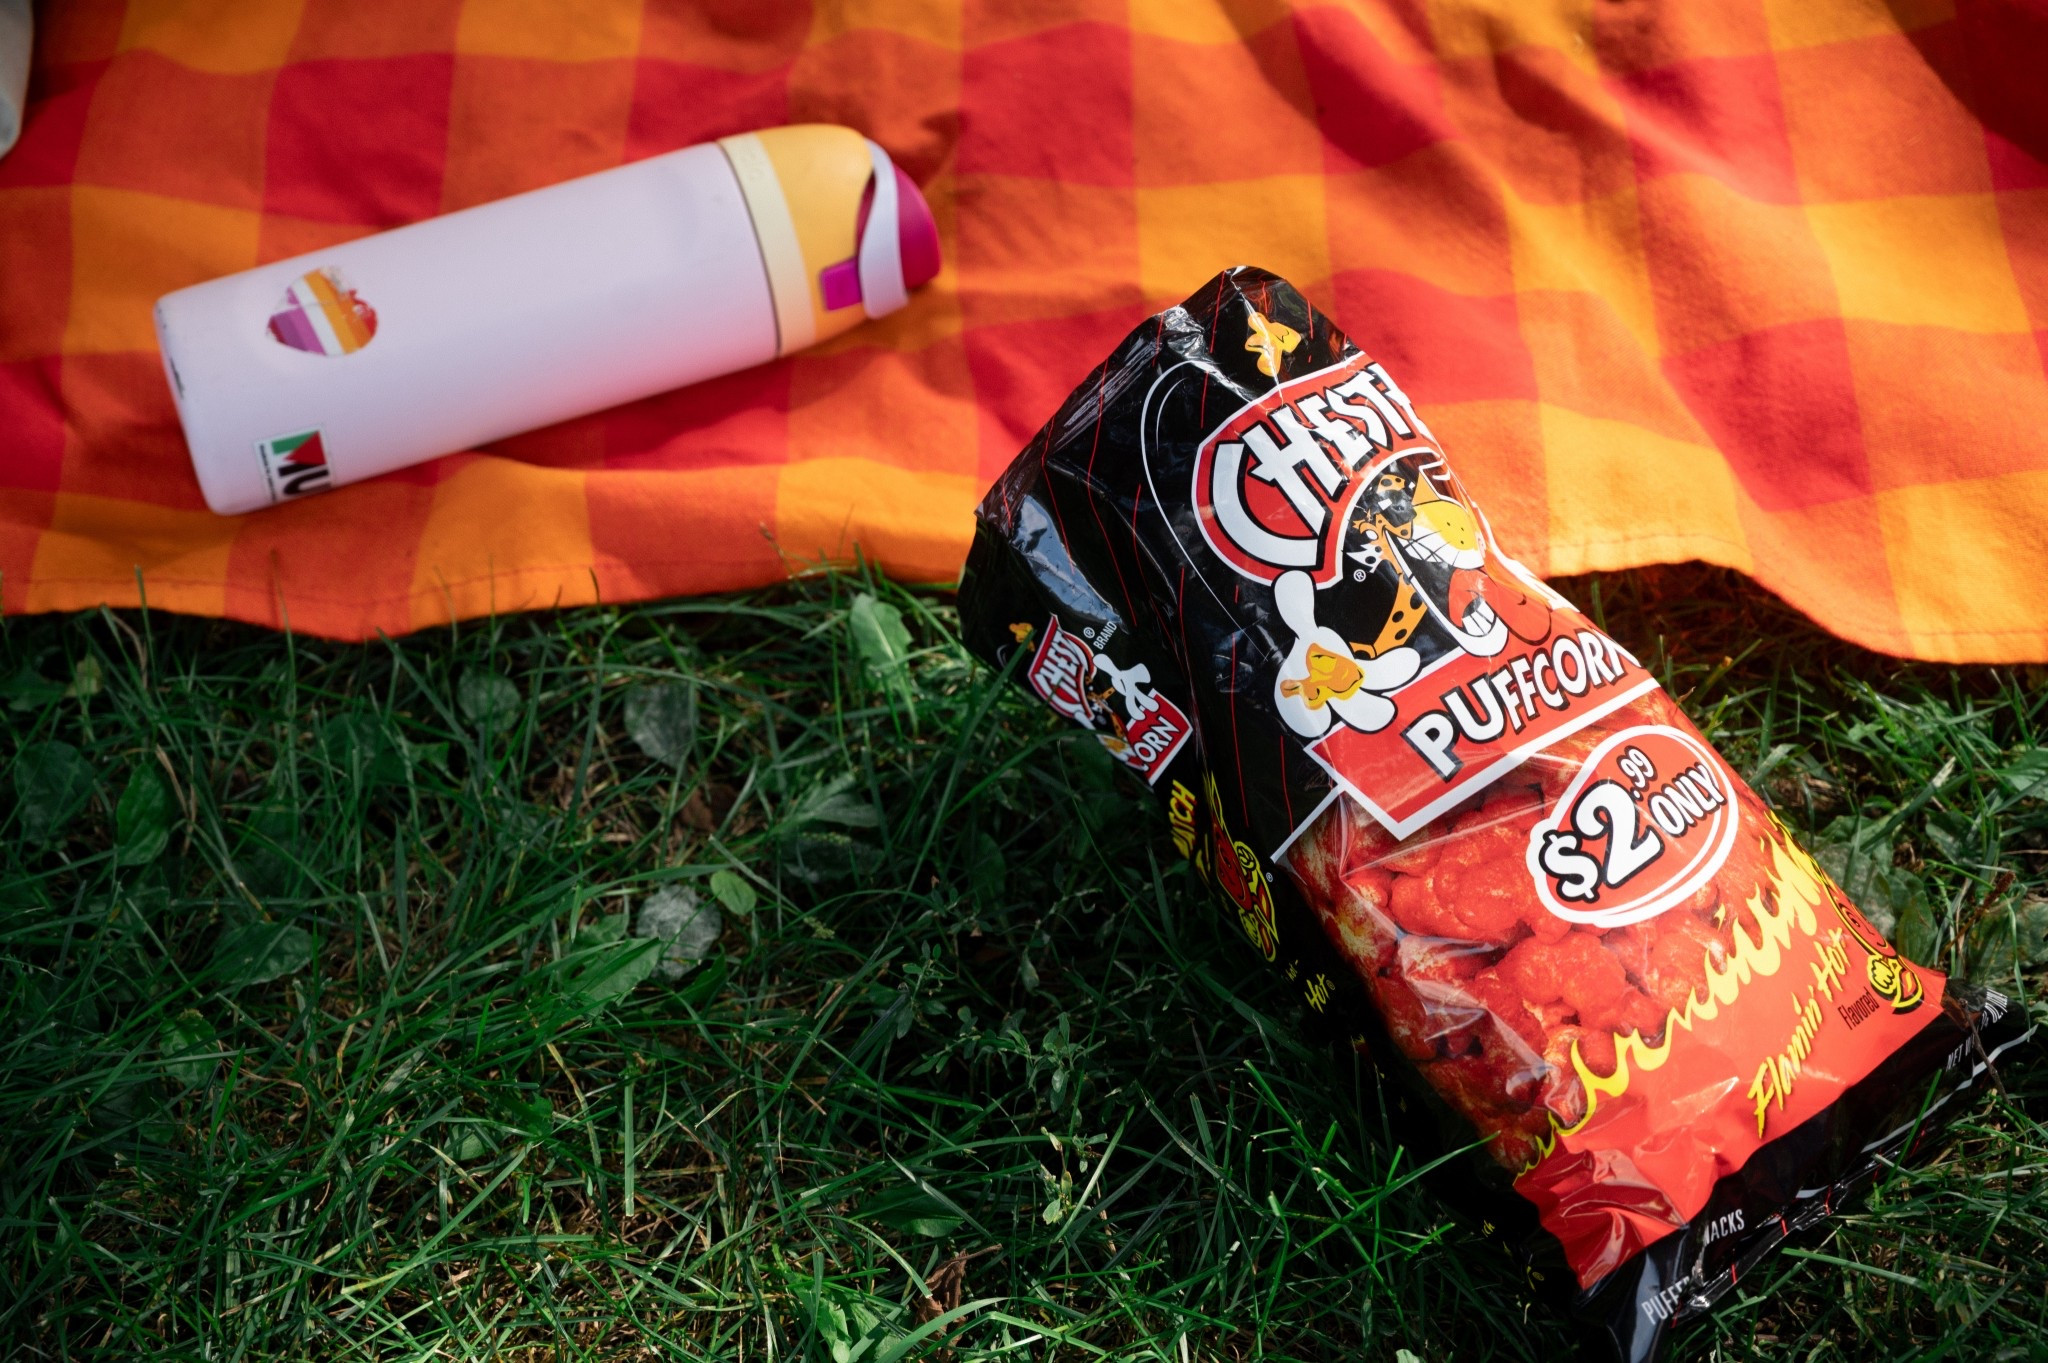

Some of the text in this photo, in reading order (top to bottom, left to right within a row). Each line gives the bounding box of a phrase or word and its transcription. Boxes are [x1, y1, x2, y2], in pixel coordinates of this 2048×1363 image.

[1093, 620, 1118, 650] BRAND
[1647, 761, 1727, 838] ONLY
[1837, 986, 1881, 1031] Flavored
